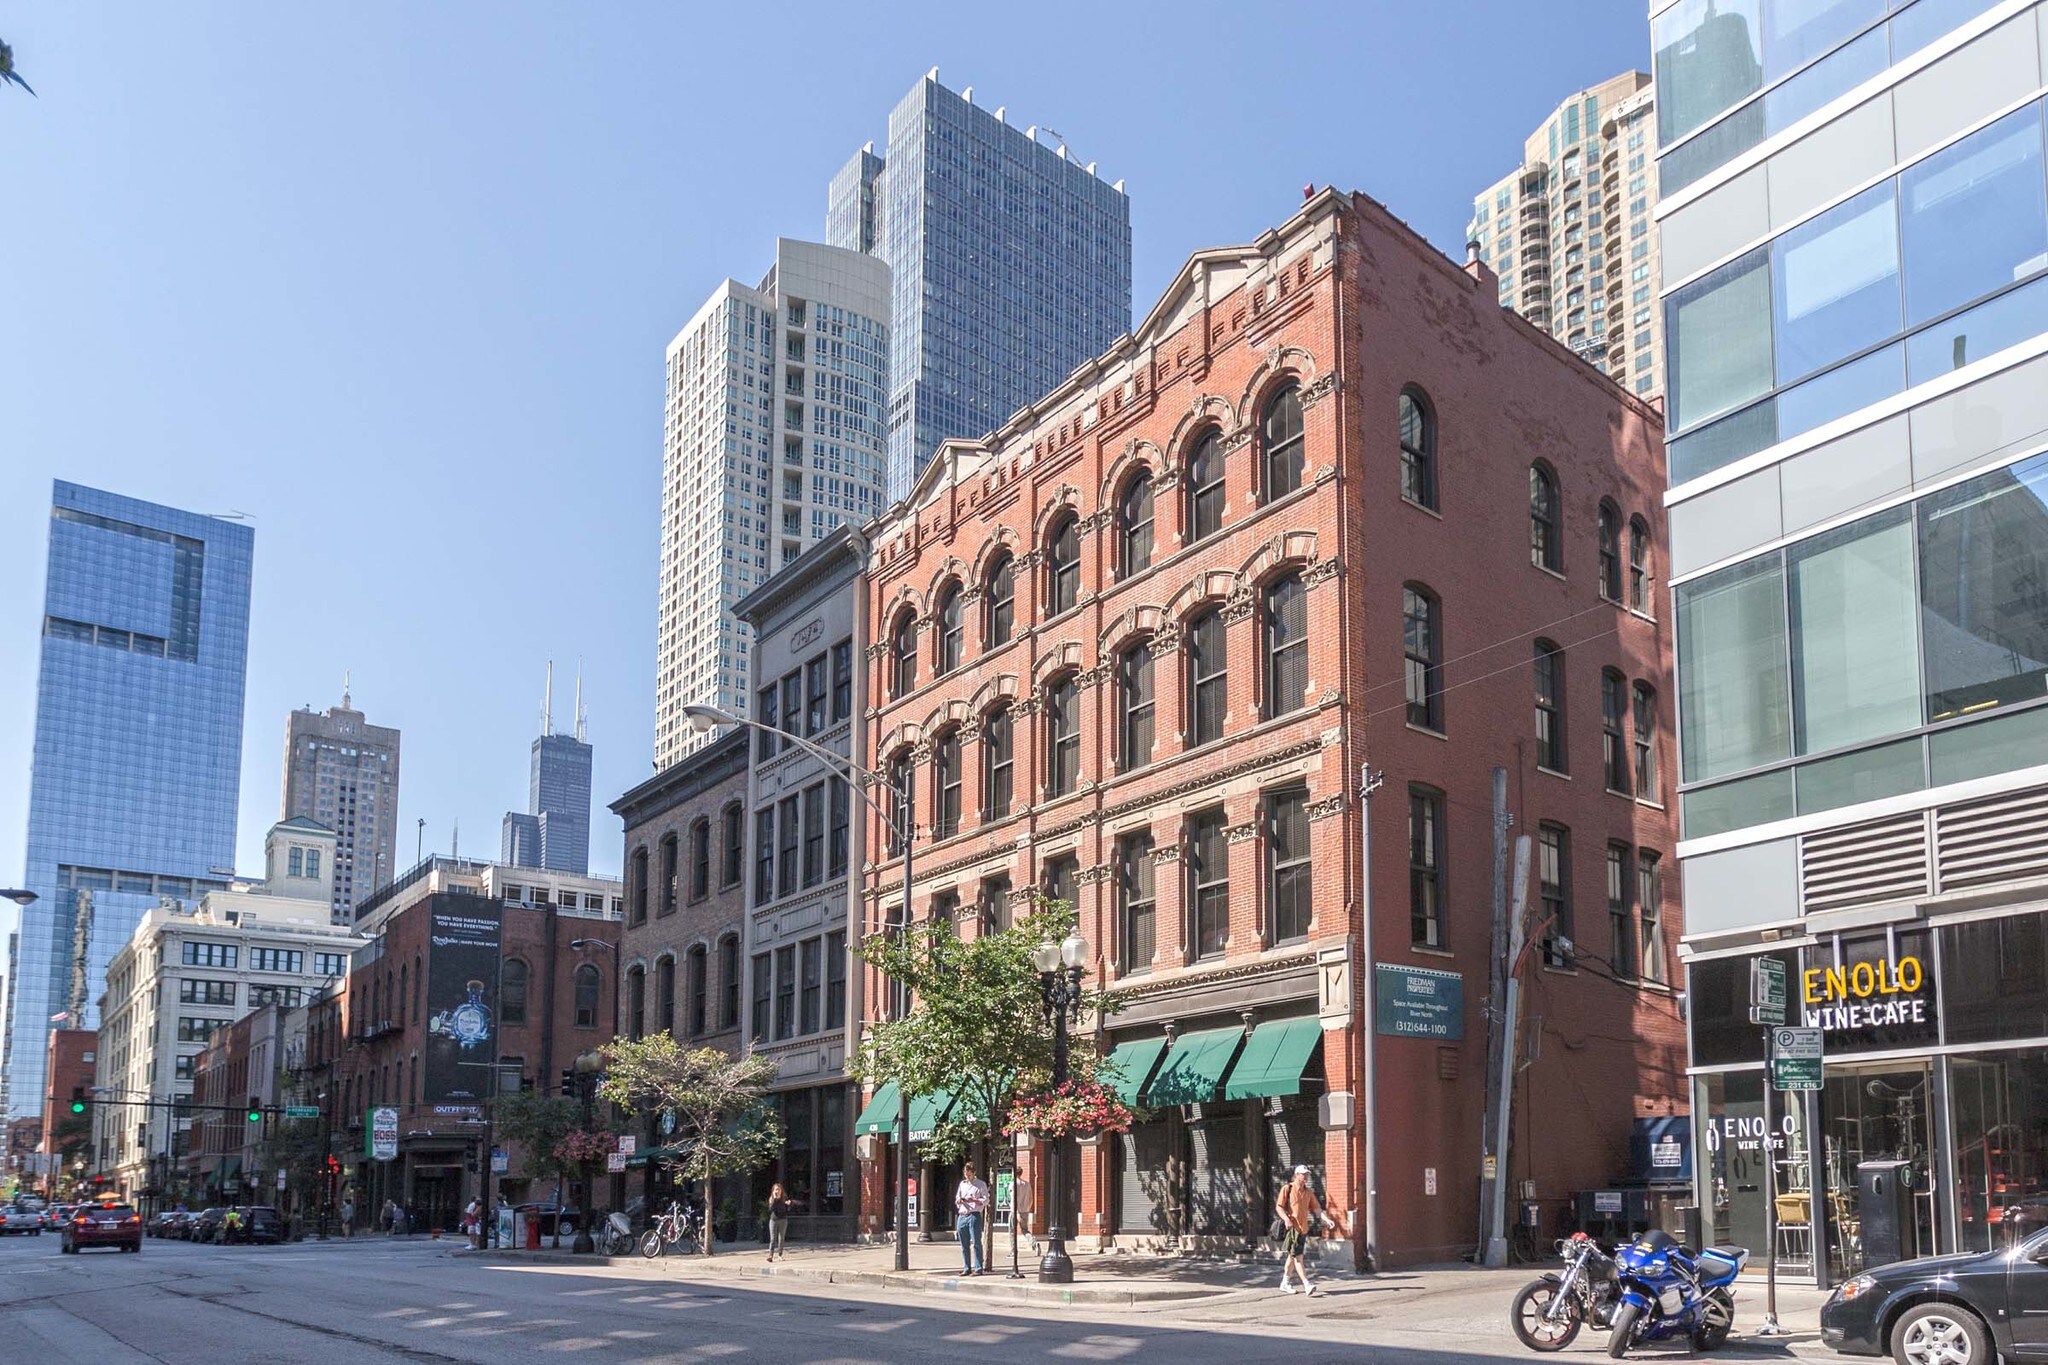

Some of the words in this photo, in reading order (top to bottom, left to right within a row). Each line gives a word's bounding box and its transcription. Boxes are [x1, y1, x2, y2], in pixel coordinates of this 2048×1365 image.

[1406, 976, 1436, 988] FRIEDMAN
[1804, 956, 1923, 1004] ENOLO
[1392, 999, 1406, 1008] Space
[1806, 1004, 1862, 1030] WINE
[1870, 1000, 1925, 1026] CAFE
[374, 1130, 396, 1140] BOSS
